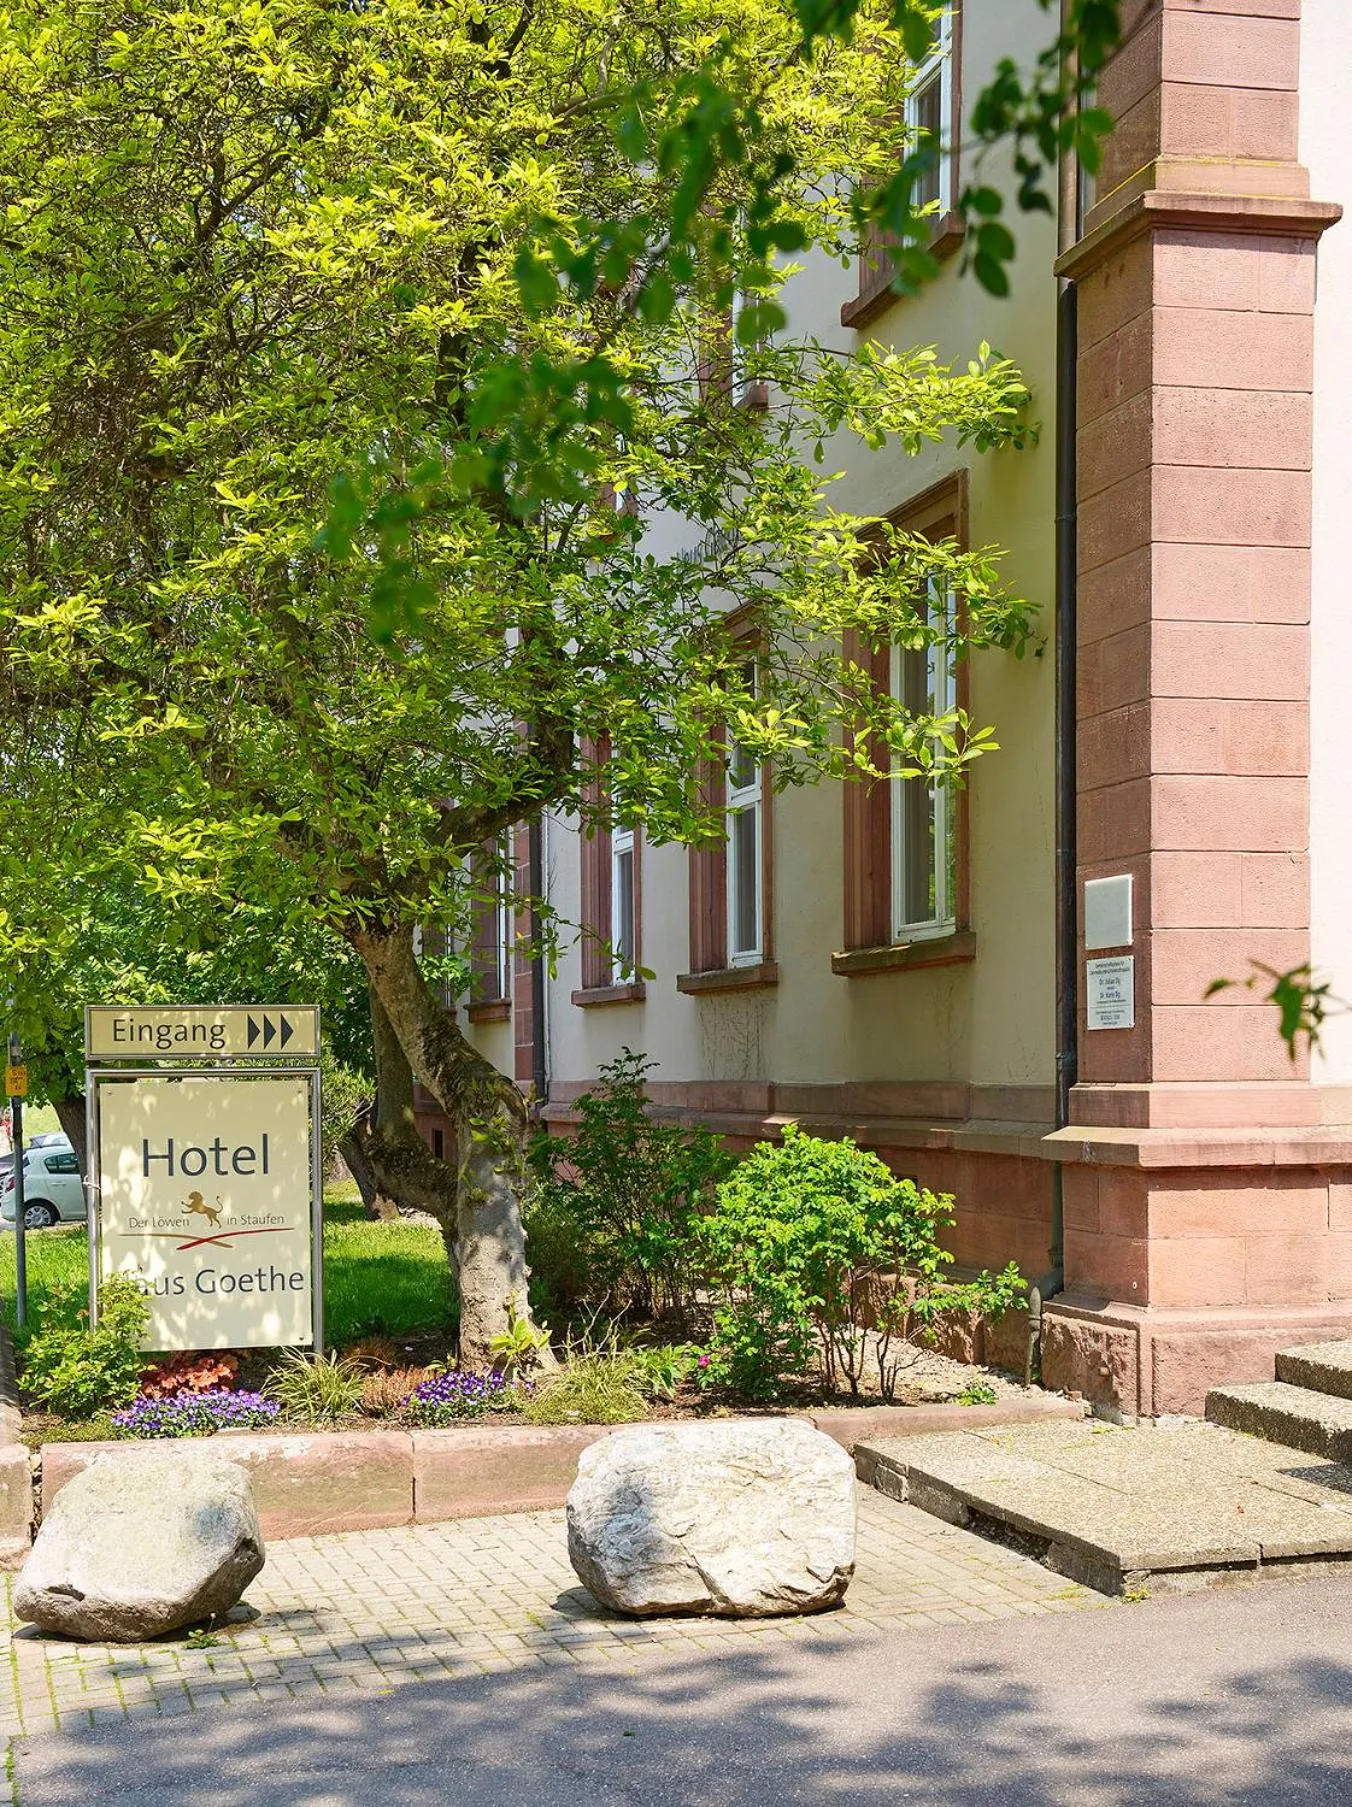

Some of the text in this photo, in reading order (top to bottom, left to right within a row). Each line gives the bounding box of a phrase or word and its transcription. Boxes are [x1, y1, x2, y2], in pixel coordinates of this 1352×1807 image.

[112, 1018, 226, 1050] Eingang
[142, 1133, 269, 1178] Hotel
[128, 1213, 285, 1229] Der Löwen in Staufen
[195, 1265, 305, 1294] Goethe
